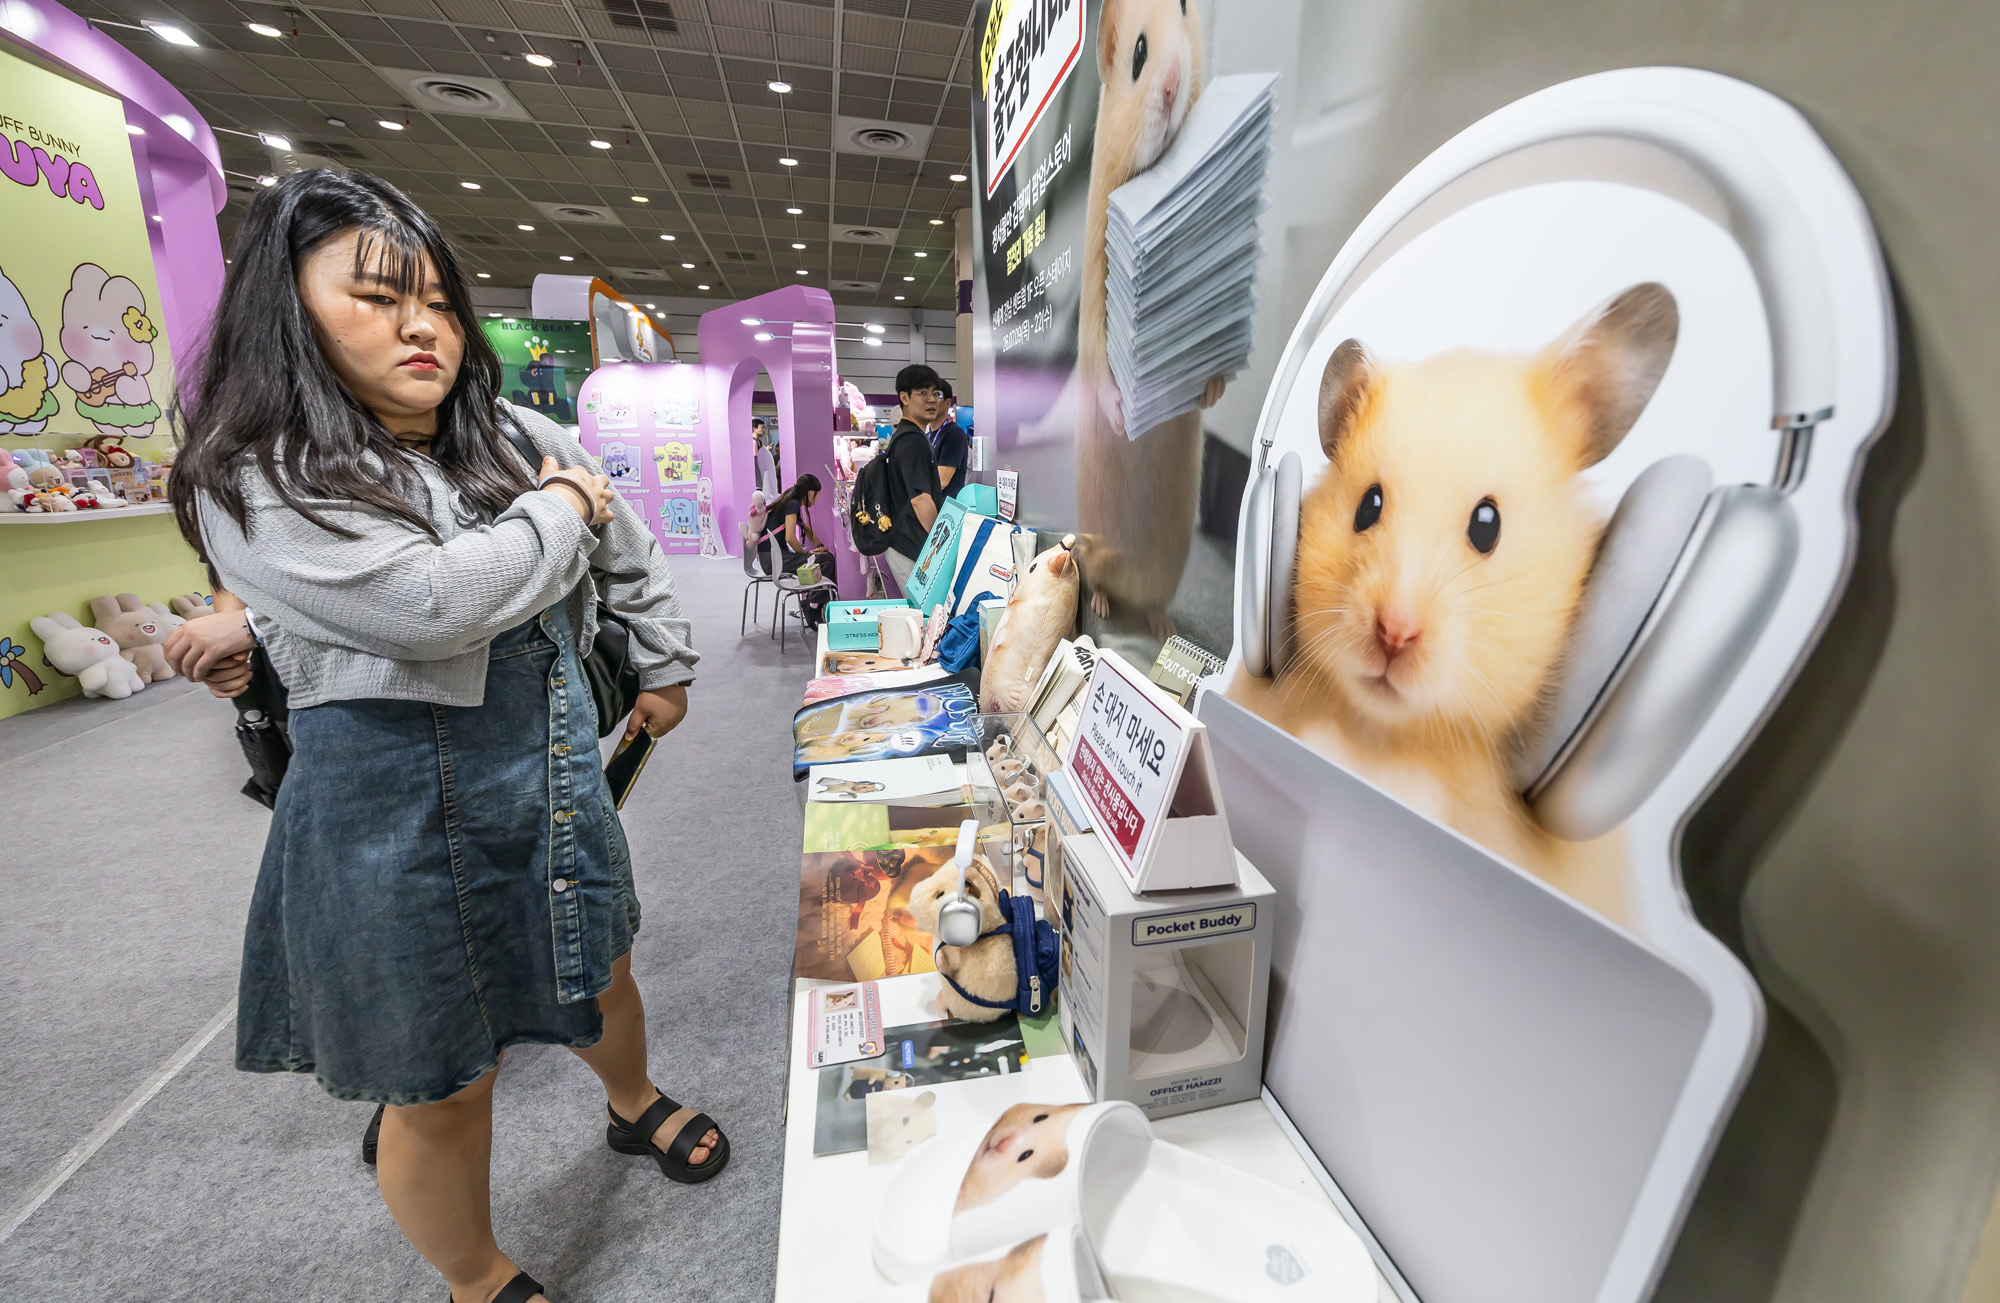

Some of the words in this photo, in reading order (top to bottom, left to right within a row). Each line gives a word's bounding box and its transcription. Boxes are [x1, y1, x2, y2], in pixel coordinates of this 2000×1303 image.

[28, 126, 80, 158] BUNNY
[992, 206, 1012, 255] 정서불안
[1013, 179, 1031, 230] 김햄찌
[1031, 123, 1072, 206] 팝업스토어
[1022, 222, 1034, 259] 가동
[1004, 297, 1012, 322] 강남
[1012, 284, 1026, 316] 센트럴
[1027, 281, 1033, 302] 1F
[1034, 270, 1045, 297] 오픈
[1046, 245, 1071, 288] 스테이지
[501, 323, 540, 332] BLACK
[542, 325, 572, 333] BEAR
[1034, 303, 1053, 334] 22(수)
[1163, 658, 1180, 675] OUT
[1177, 666, 1190, 680] OF
[1186, 672, 1202, 689] OFF
[1092, 681, 1105, 714] 손
[1104, 691, 1128, 738] 대지
[1126, 713, 1165, 777] 마세요
[1090, 722, 1105, 750] Please
[1104, 741, 1119, 768] don't
[1118, 758, 1136, 790] touch
[1134, 780, 1143, 797] it
[1093, 765, 1105, 790] 않는
[1103, 778, 1140, 837] 전시용입니다
[1147, 921, 1195, 936] Pocket
[1199, 913, 1242, 929] Buddy
[1149, 1085, 1184, 1097] OFFICE
[1186, 1077, 1222, 1090] HAMZZI
